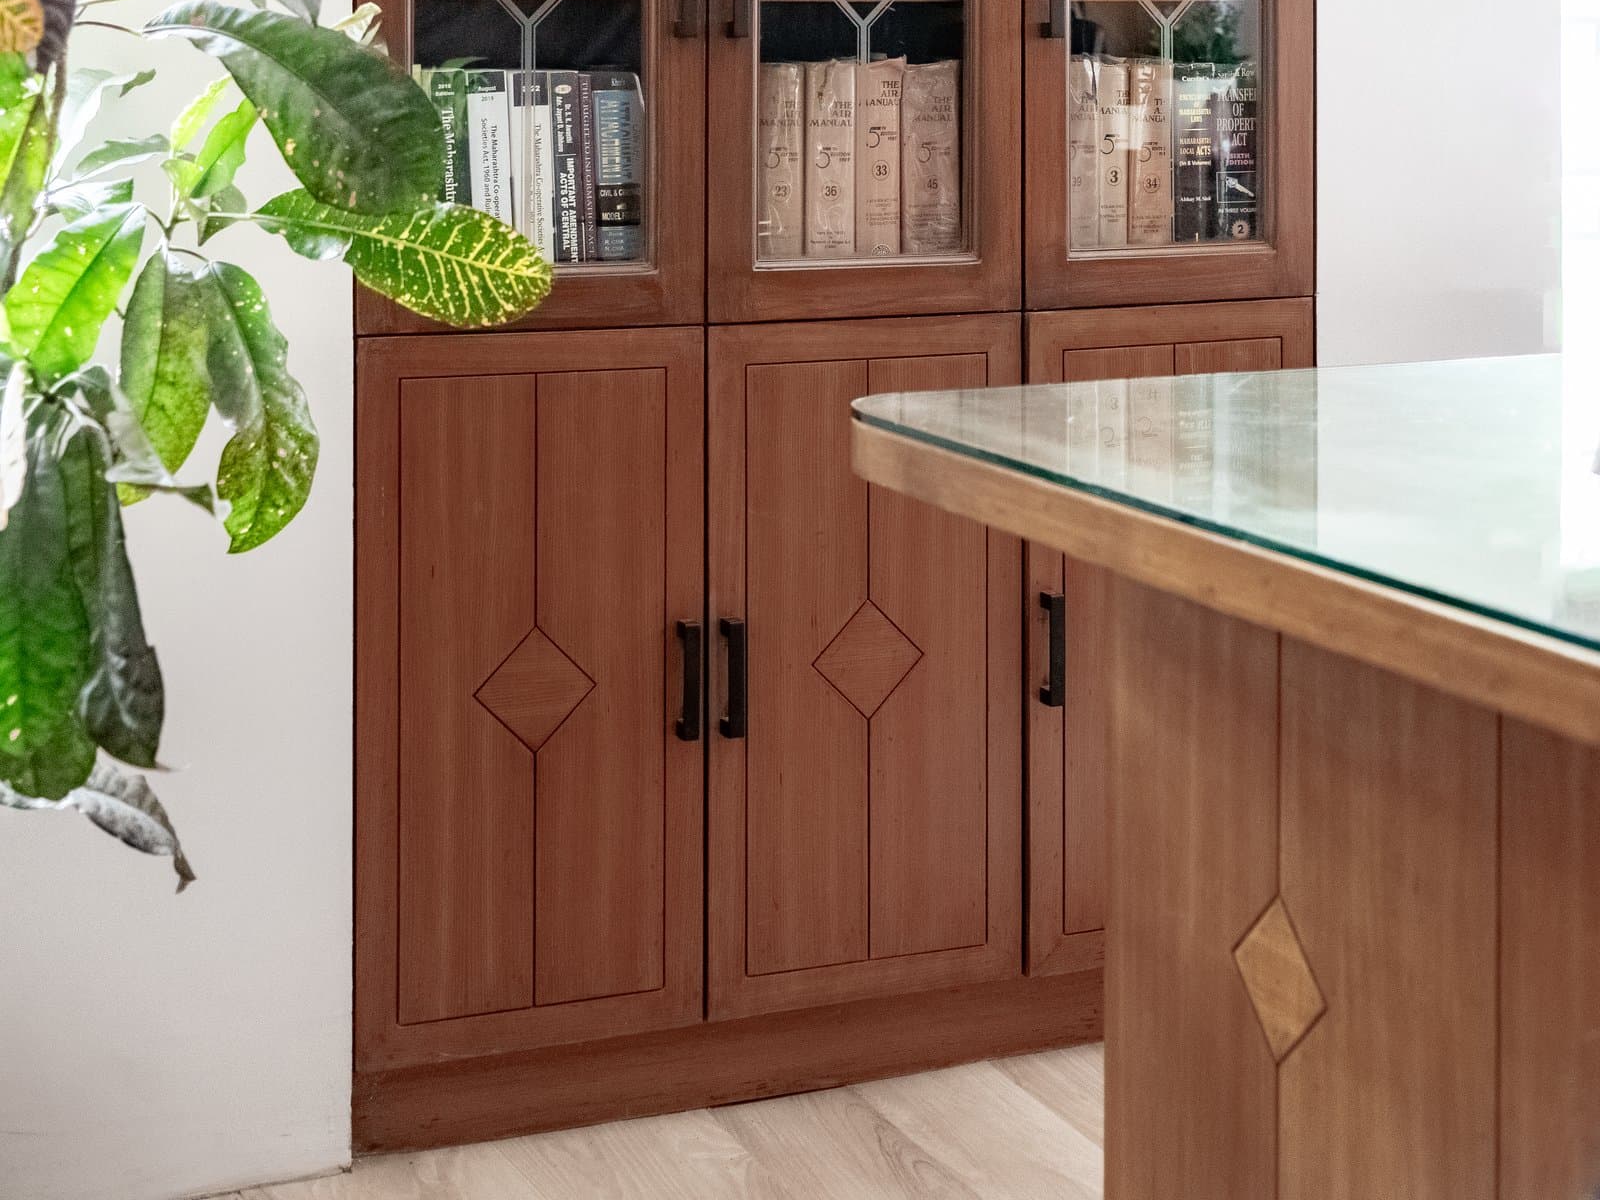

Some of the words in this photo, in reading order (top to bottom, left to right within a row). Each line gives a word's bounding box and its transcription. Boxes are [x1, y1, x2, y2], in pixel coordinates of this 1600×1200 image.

[881, 80, 900, 90] THE
[882, 89, 900, 99] AIR
[833, 110, 852, 119] AIR
[834, 101, 853, 110] THE
[1231, 102, 1245, 117] OF
[441, 107, 456, 131] The
[809, 118, 853, 128] MANUAL
[480, 118, 489, 149] Societies
[866, 126, 881, 149] 5
[1231, 132, 1248, 147] ACT
[918, 142, 934, 164] 5
[1100, 134, 1116, 155] 5
[1180, 147, 1195, 155] LOCAL
[1196, 145, 1212, 157] ACTS
[491, 139, 500, 184] Maharashtra
[535, 137, 543, 177] Maharashtra
[765, 147, 781, 170] 5
[816, 147, 831, 170] 5
[443, 132, 458, 204] Maharashtr
[483, 165, 491, 183] 1960
[874, 162, 888, 177] 33
[1110, 170, 1119, 184] 3
[559, 172, 568, 197] ACTS
[566, 158, 576, 208] IMPORTANT
[774, 184, 788, 198] 23
[825, 184, 838, 198] 36
[1145, 176, 1159, 190] 34
[536, 177, 544, 217] Co-operative
[560, 197, 569, 209] OF
[537, 217, 545, 245] Societies
[561, 210, 570, 251] CENTRAL
[569, 210, 579, 264] AMENDMENT
[1236, 223, 1245, 236] 2
